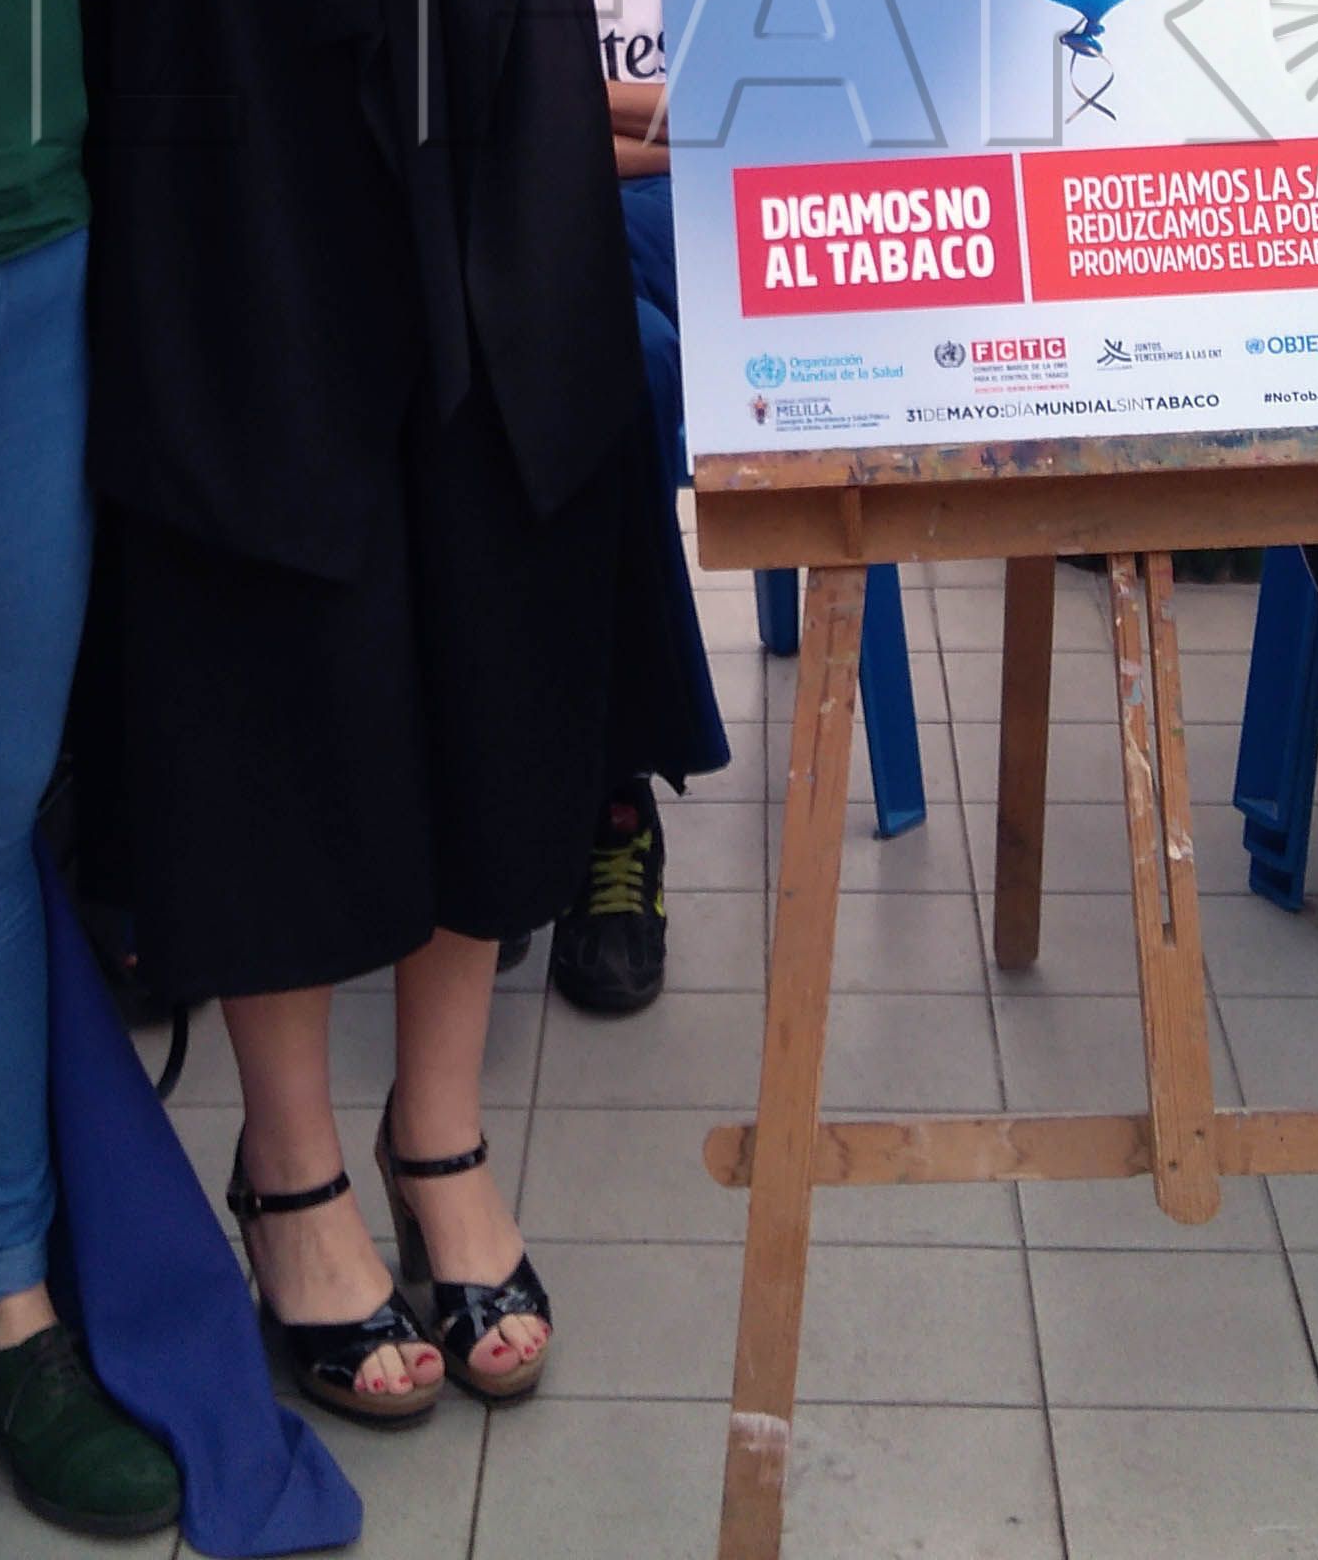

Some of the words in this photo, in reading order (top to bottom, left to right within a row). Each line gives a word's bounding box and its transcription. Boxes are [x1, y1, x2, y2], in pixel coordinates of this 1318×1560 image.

[1062, 167, 1252, 212] PROTEJAMOS
[1254, 166, 1294, 203] LA
[760, 187, 933, 241] DIGAMOS
[934, 185, 992, 232] NO
[1065, 205, 1235, 245] REDUZCAMOS
[1238, 204, 1272, 236] LA
[764, 243, 819, 290] AL
[825, 233, 996, 286] TABACO
[1068, 242, 1226, 278] PROMOVAMOS
[1229, 240, 1255, 270] EL
[790, 354, 863, 369] Organización
[973, 338, 1065, 362] FCTC
[790, 368, 835, 382] Mundial
[840, 369, 855, 381] de
[858, 367, 870, 380] la
[872, 365, 904, 379] Salud
[775, 403, 834, 418] MELILLA
